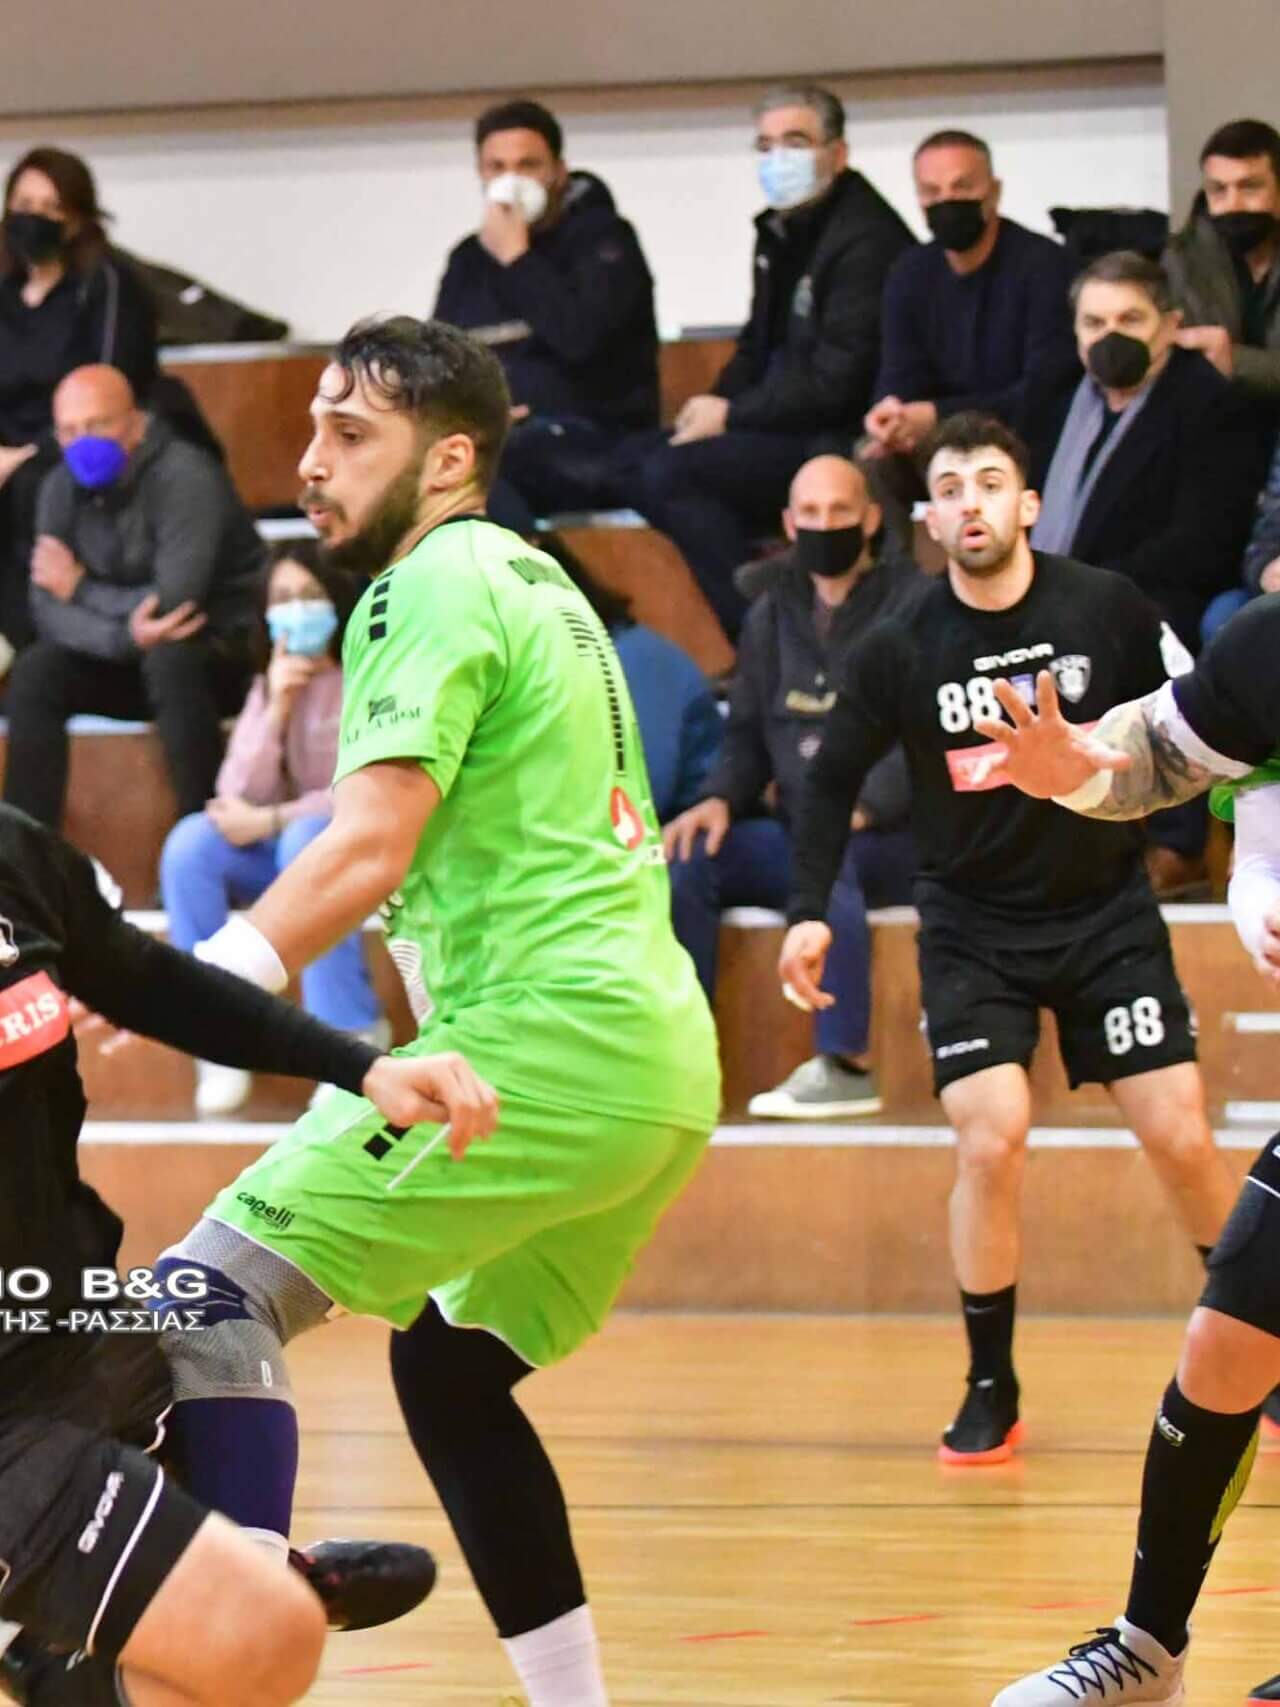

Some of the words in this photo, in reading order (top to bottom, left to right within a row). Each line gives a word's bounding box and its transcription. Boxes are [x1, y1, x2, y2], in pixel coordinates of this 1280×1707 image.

[936, 676, 1003, 734] 88
[1104, 996, 1165, 1055] 88
[236, 1191, 296, 1228] capelli
